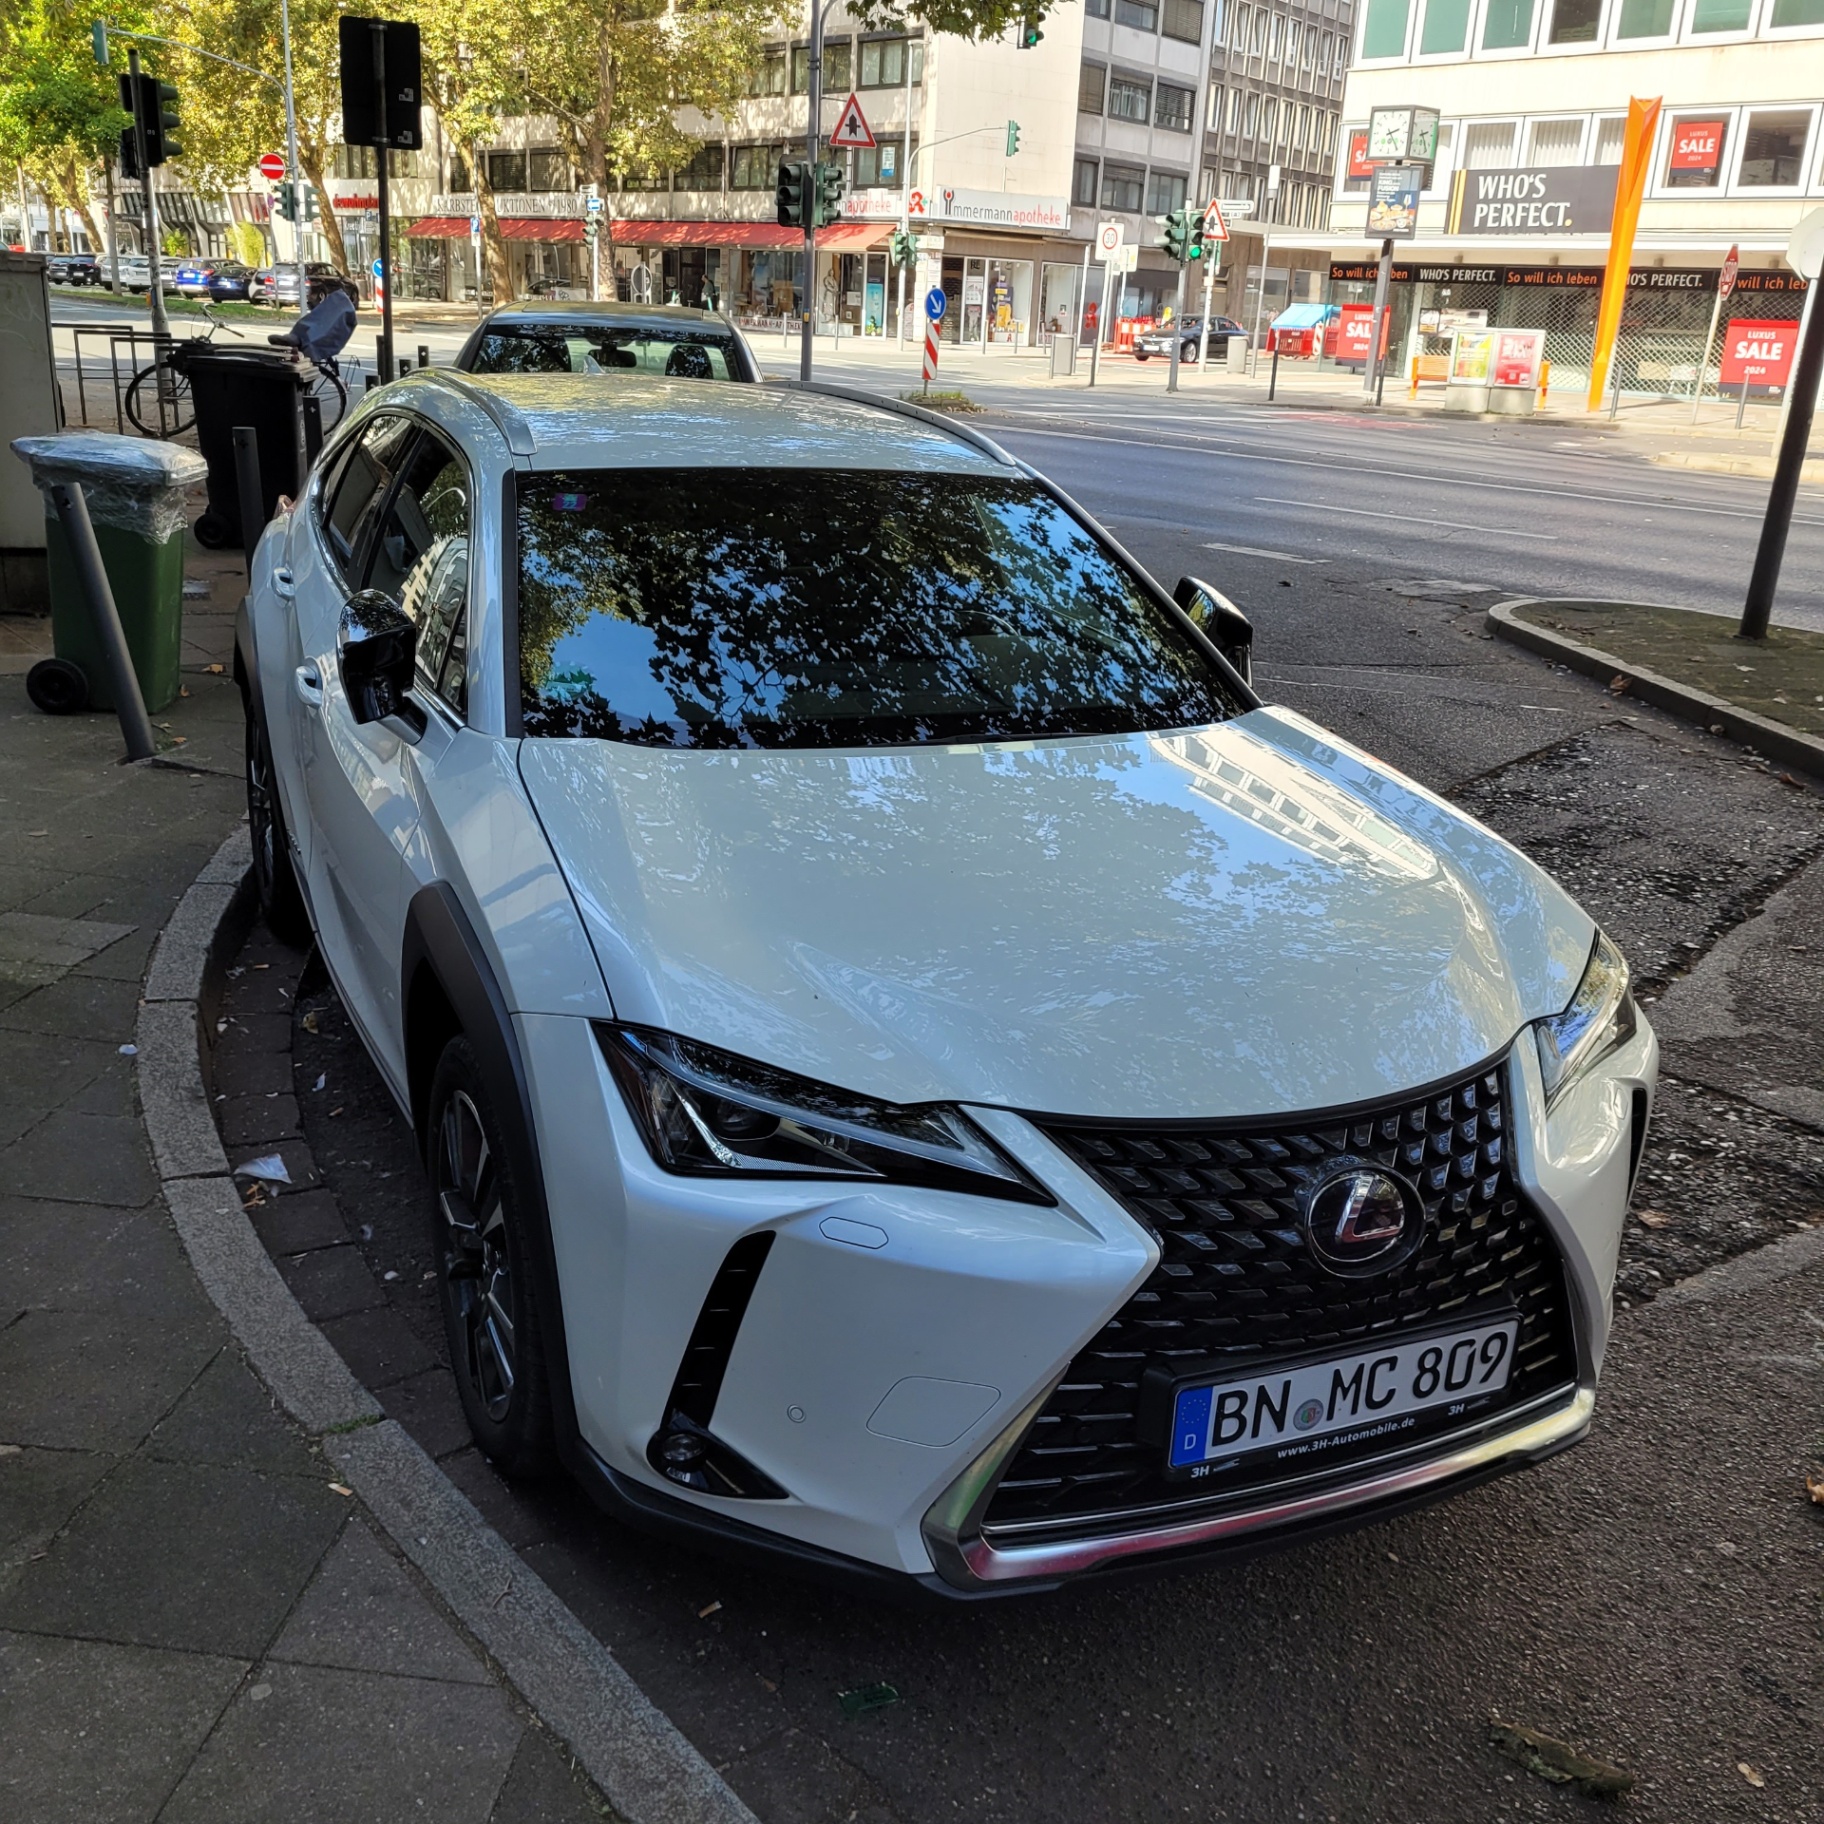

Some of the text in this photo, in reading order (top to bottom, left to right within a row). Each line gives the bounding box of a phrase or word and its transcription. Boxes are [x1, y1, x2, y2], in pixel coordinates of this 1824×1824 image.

[1679, 138, 1716, 153] SALE
[1478, 174, 1547, 199] WHO'S
[497, 199, 547, 213] UKTIONEN
[1473, 202, 1573, 227] PERFECT.
[1105, 233, 1115, 244] 30
[1332, 267, 1343, 278] So
[1345, 267, 1363, 278] will
[1390, 267, 1408, 279] ben
[1419, 268, 1497, 282] WHO'S PERFECT.
[1507, 271, 1598, 285] So will ich leben
[1651, 274, 1703, 287] PERFECT.
[1737, 276, 1809, 290] will ich leb
[1346, 322, 1372, 338] SAL
[1747, 331, 1776, 340] LUXUS
[1735, 341, 1784, 360] SALE
[1744, 366, 1766, 375] 2024
[1211, 1331, 1509, 1447] BN MC 809
[1448, 1404, 1465, 1416] 3H
[1184, 1433, 1197, 1450] D
[1277, 1417, 1415, 1459] www.3H-Automobile.de
[1191, 1465, 1210, 1478] 3H
